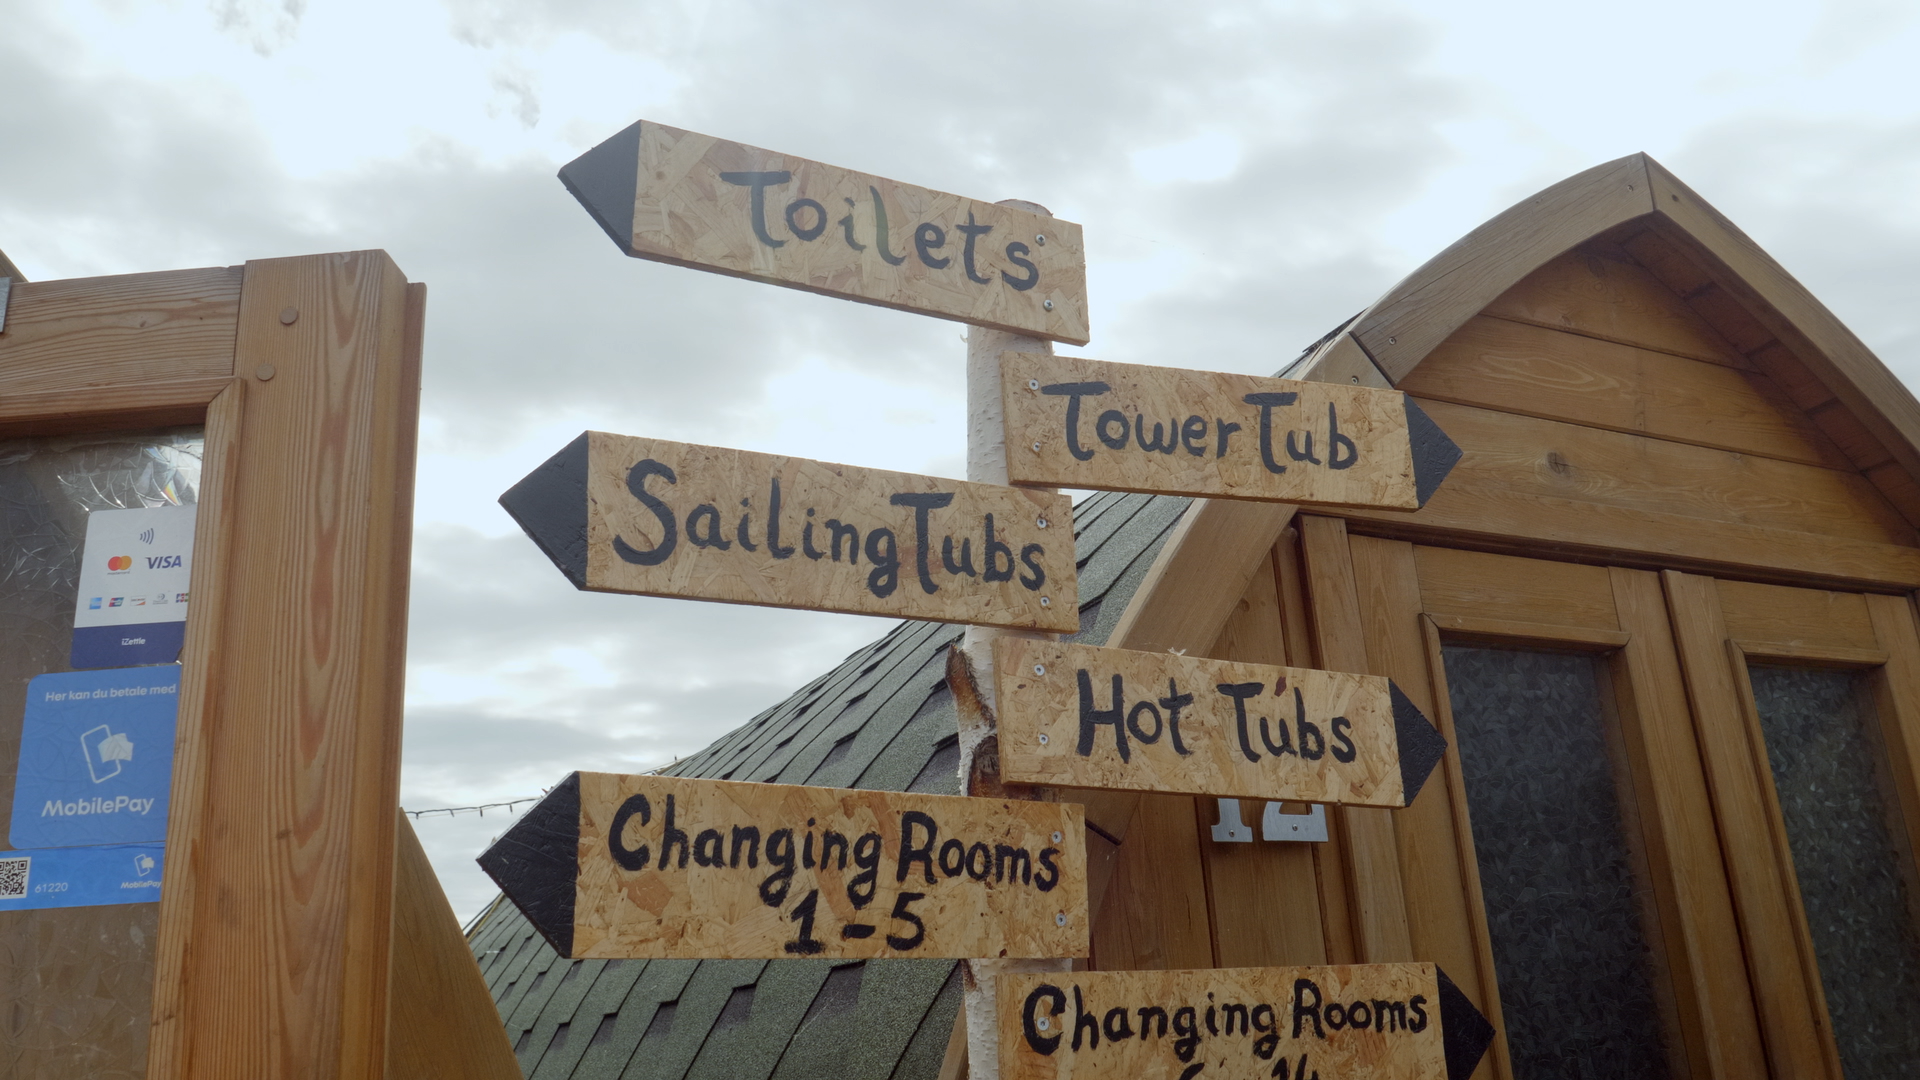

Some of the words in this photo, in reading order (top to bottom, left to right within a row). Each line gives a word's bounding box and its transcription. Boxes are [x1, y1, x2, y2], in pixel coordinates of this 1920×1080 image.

[719, 170, 1039, 291] Toilets
[1041, 381, 1241, 462] Tower
[1243, 392, 1360, 474] Tub
[145, 555, 182, 570] VISA
[612, 459, 900, 598] Sailing
[890, 492, 1046, 594] Tubs
[45, 691, 67, 702] Her
[69, 690, 90, 700] kan
[92, 689, 108, 699] du
[110, 686, 148, 698] betale
[149, 684, 177, 695] med
[1076, 669, 1195, 764] Hot
[1216, 682, 1357, 763] Tubs
[41, 796, 155, 817] MobilePay
[34, 882, 69, 894] 61220
[120, 880, 162, 889] MobilePay
[608, 794, 882, 909] Changing
[896, 810, 1060, 892] Rooms
[1022, 983, 1280, 1063] Changing
[1293, 978, 1429, 1040] Rooms
